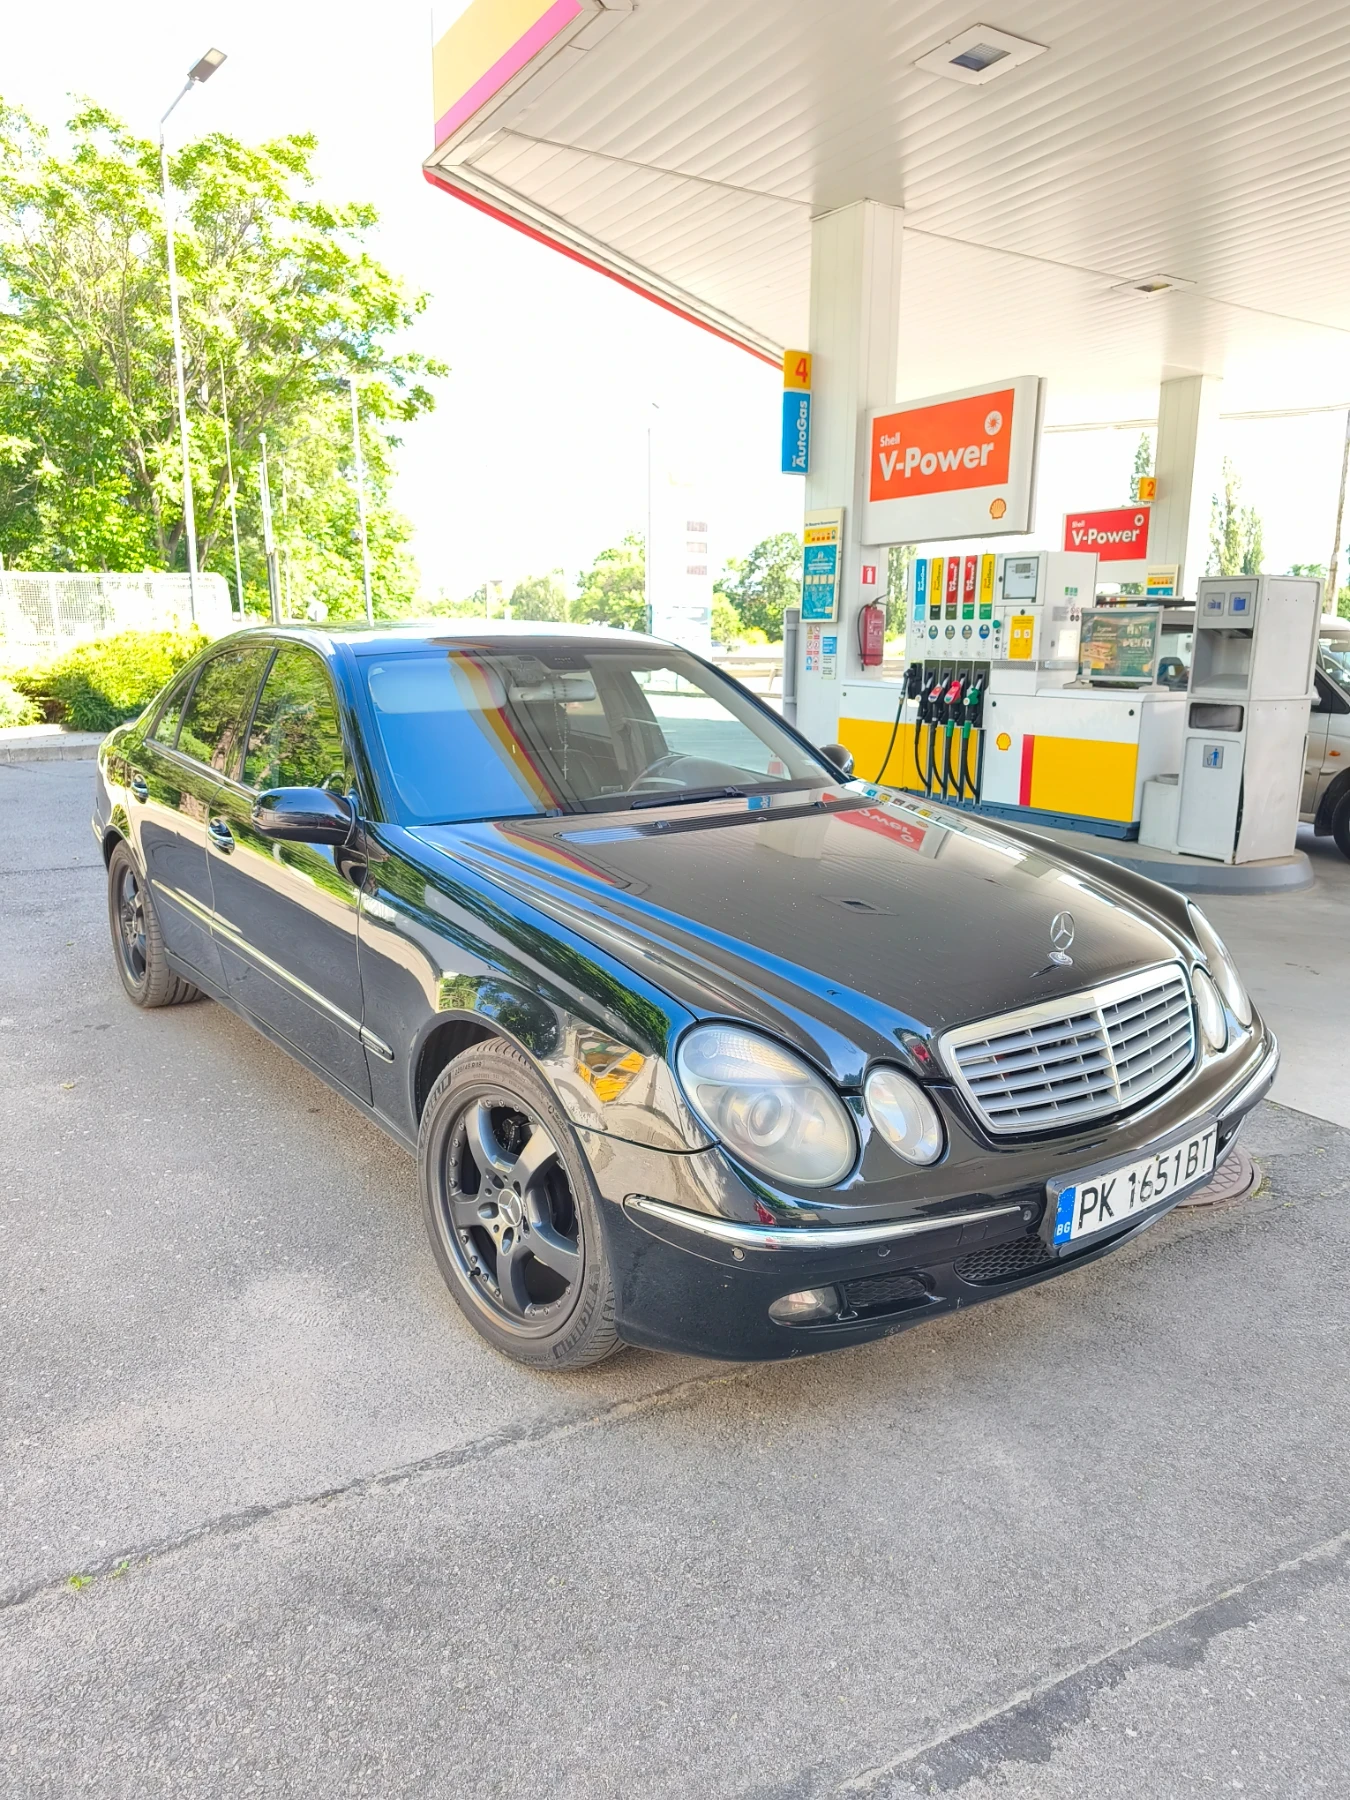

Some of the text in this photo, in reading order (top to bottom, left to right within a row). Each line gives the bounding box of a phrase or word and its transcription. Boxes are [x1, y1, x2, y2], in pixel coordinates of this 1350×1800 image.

[795, 358, 808, 383] 4
[796, 400, 808, 468] AutoGas
[880, 432, 901, 447] Shell
[879, 442, 994, 482] V-Power
[1147, 481, 1155, 497] 2
[1071, 528, 1140, 546] V-Power
[1078, 1178, 1117, 1230] PK
[1056, 1222, 1071, 1236] BG
